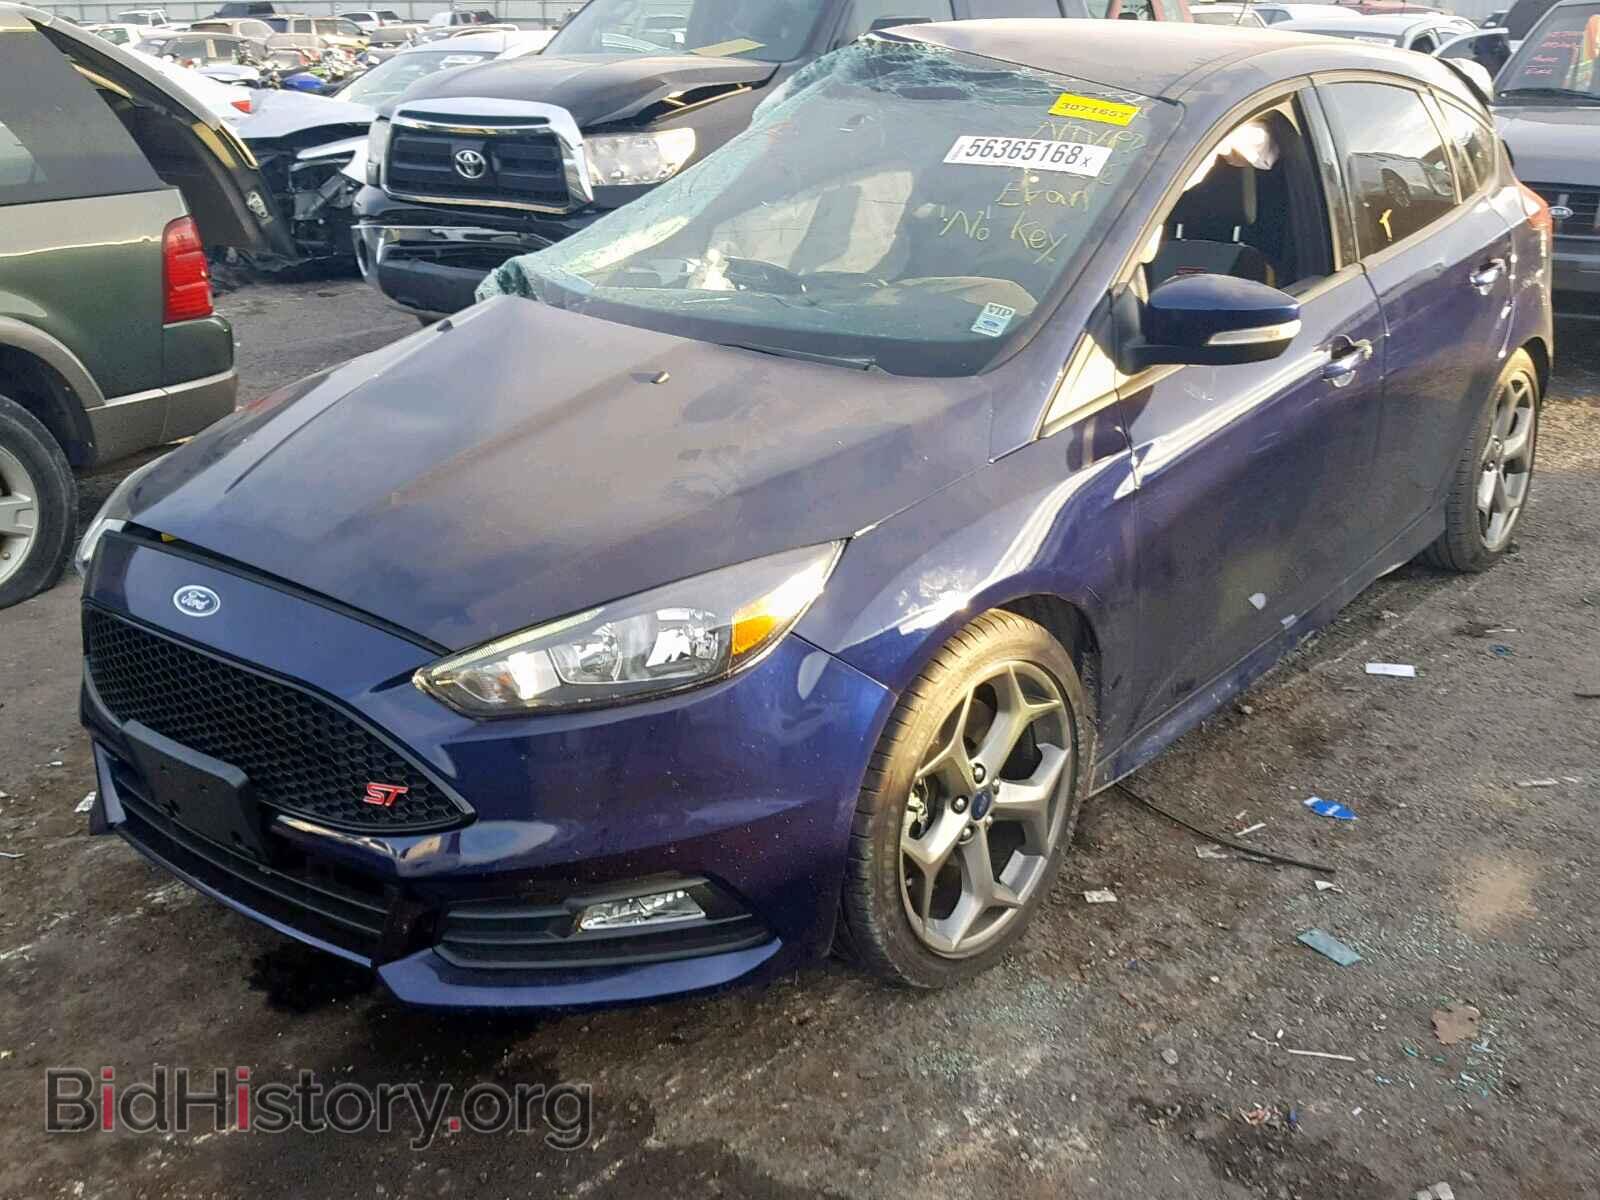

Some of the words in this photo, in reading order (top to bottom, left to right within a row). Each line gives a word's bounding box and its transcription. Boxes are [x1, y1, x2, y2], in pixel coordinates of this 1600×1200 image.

[965, 138, 1084, 165] 56365168
[181, 590, 210, 610] Ford
[363, 781, 408, 807] ST
